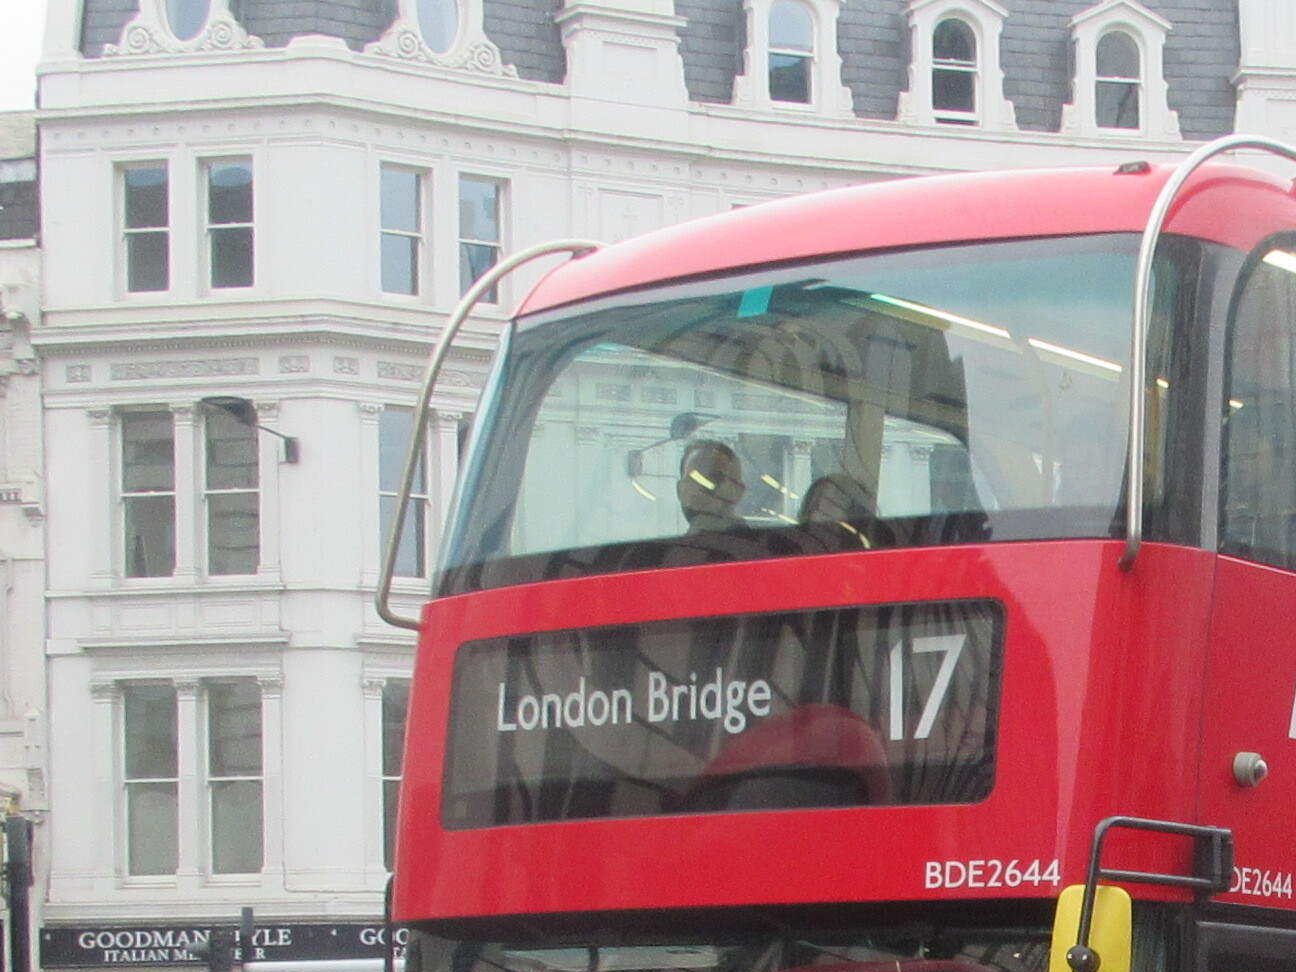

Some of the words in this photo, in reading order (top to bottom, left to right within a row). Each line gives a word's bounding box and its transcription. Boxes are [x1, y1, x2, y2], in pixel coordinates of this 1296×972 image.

[497, 678, 634, 731] London
[647, 668, 772, 735] Bridge
[888, 632, 968, 741] 17
[924, 859, 1061, 889] BDE2644
[1229, 865, 1293, 899] DE2644
[78, 930, 211, 949] GOODMAN
[104, 949, 170, 962] ITALIAN
